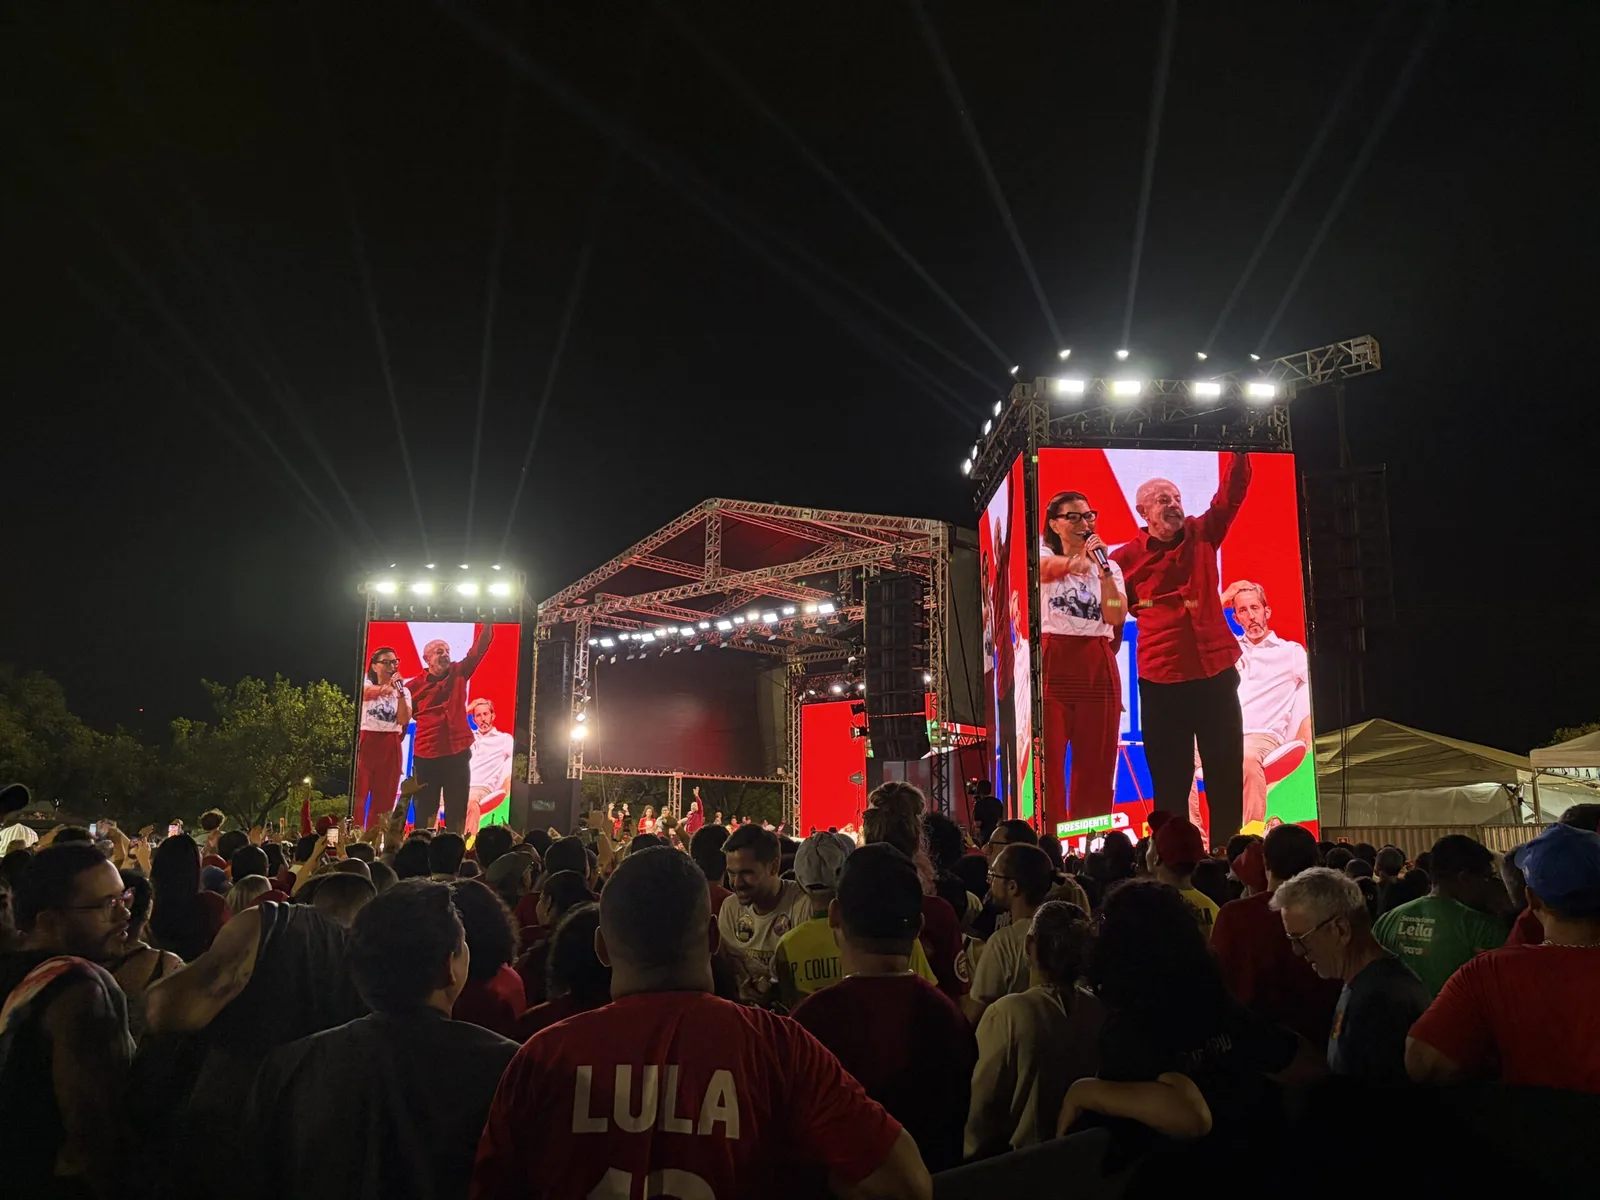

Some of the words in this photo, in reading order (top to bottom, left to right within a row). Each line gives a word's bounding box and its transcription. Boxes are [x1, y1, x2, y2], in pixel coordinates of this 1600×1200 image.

[1060, 817, 1109, 833] PRESIDENTE
[1398, 922, 1433, 938] Leila
[572, 1064, 740, 1140] LULA
